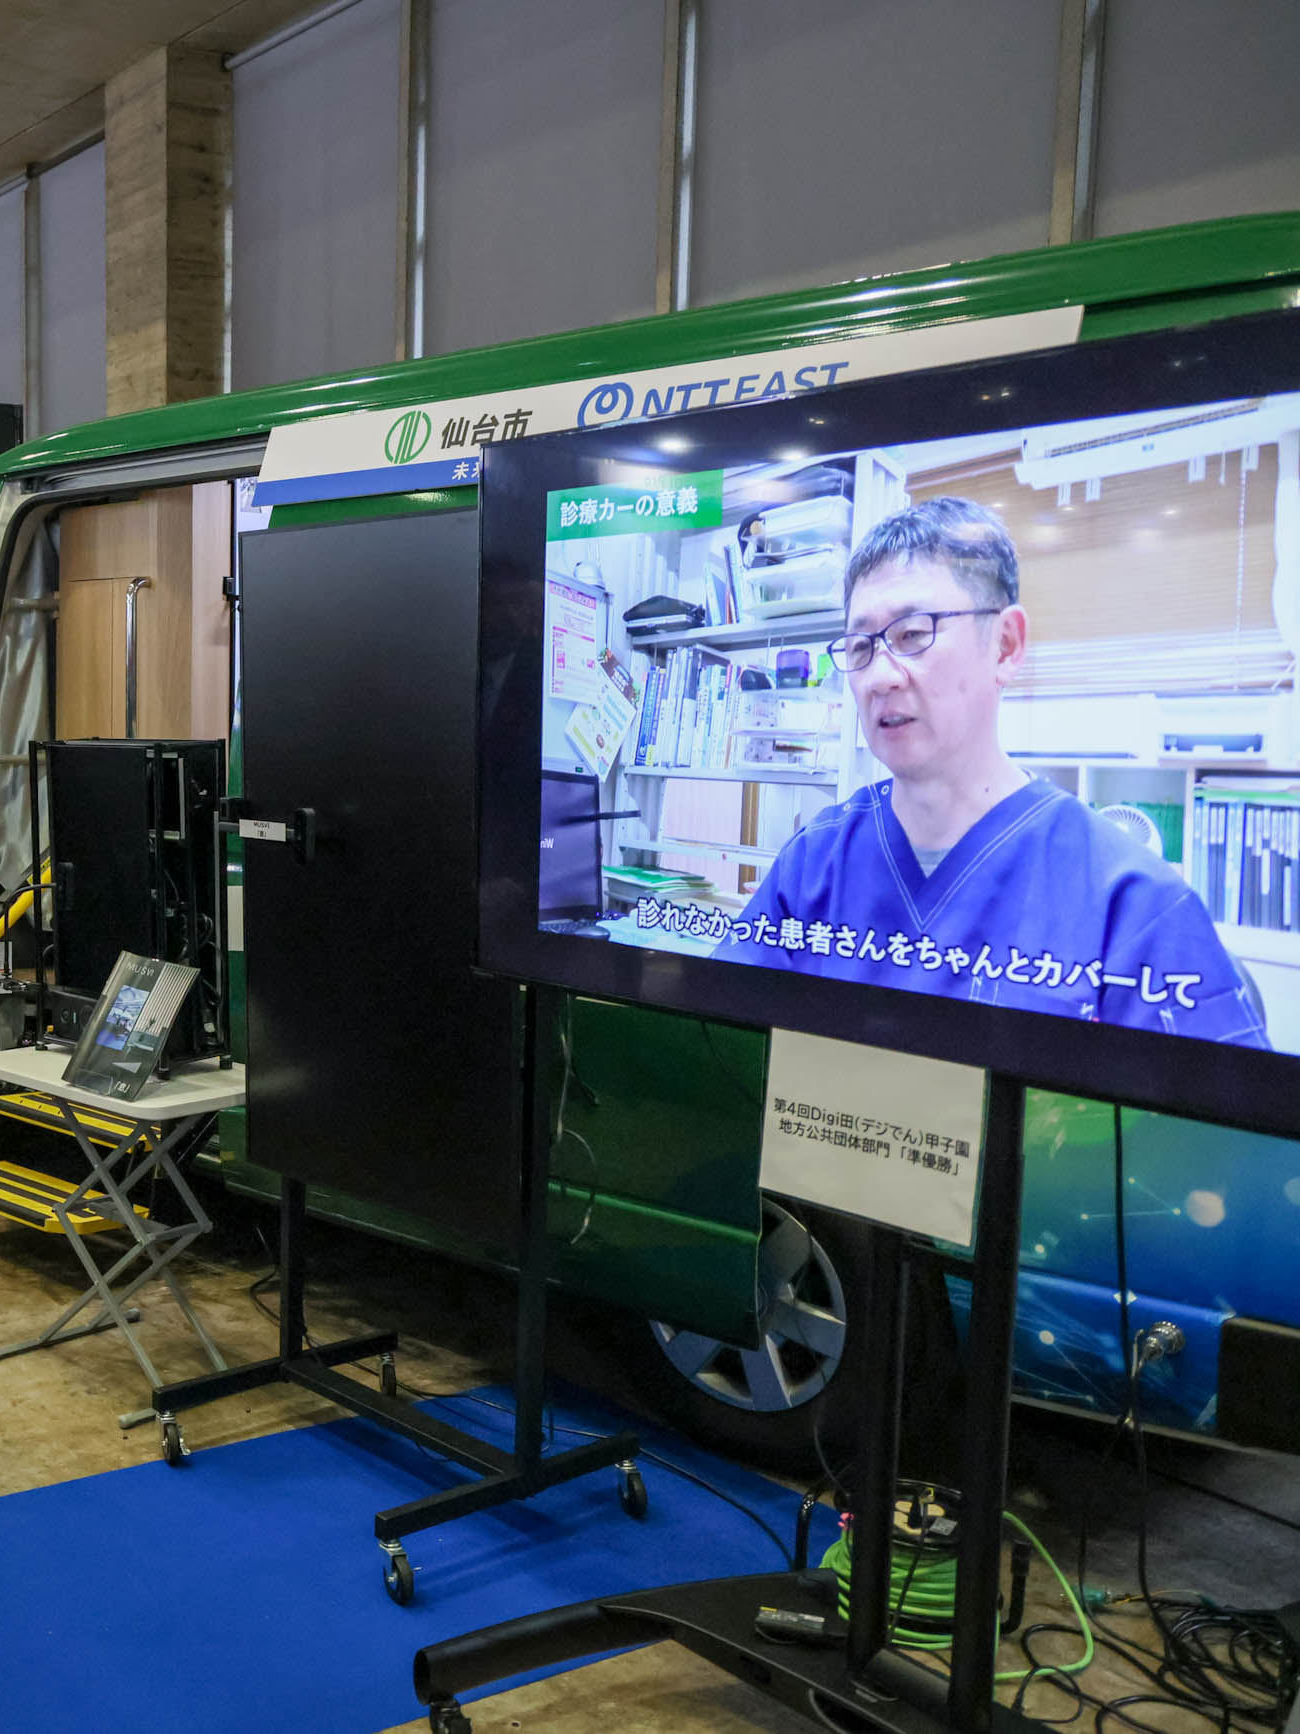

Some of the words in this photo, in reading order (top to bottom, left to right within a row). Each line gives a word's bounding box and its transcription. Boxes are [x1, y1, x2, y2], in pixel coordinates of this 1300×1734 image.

[641, 378, 731, 417] NTT
[734, 361, 849, 401] EAST
[441, 408, 533, 450] 仙台市
[560, 486, 698, 528] 診療カーの意義
[126, 961, 155, 977] MUSVI
[637, 897, 1201, 1009] 診れなかった患者さんをちゃんとカバーして
[773, 1097, 971, 1158] 第4回Digi田(デジでん)甲子園
